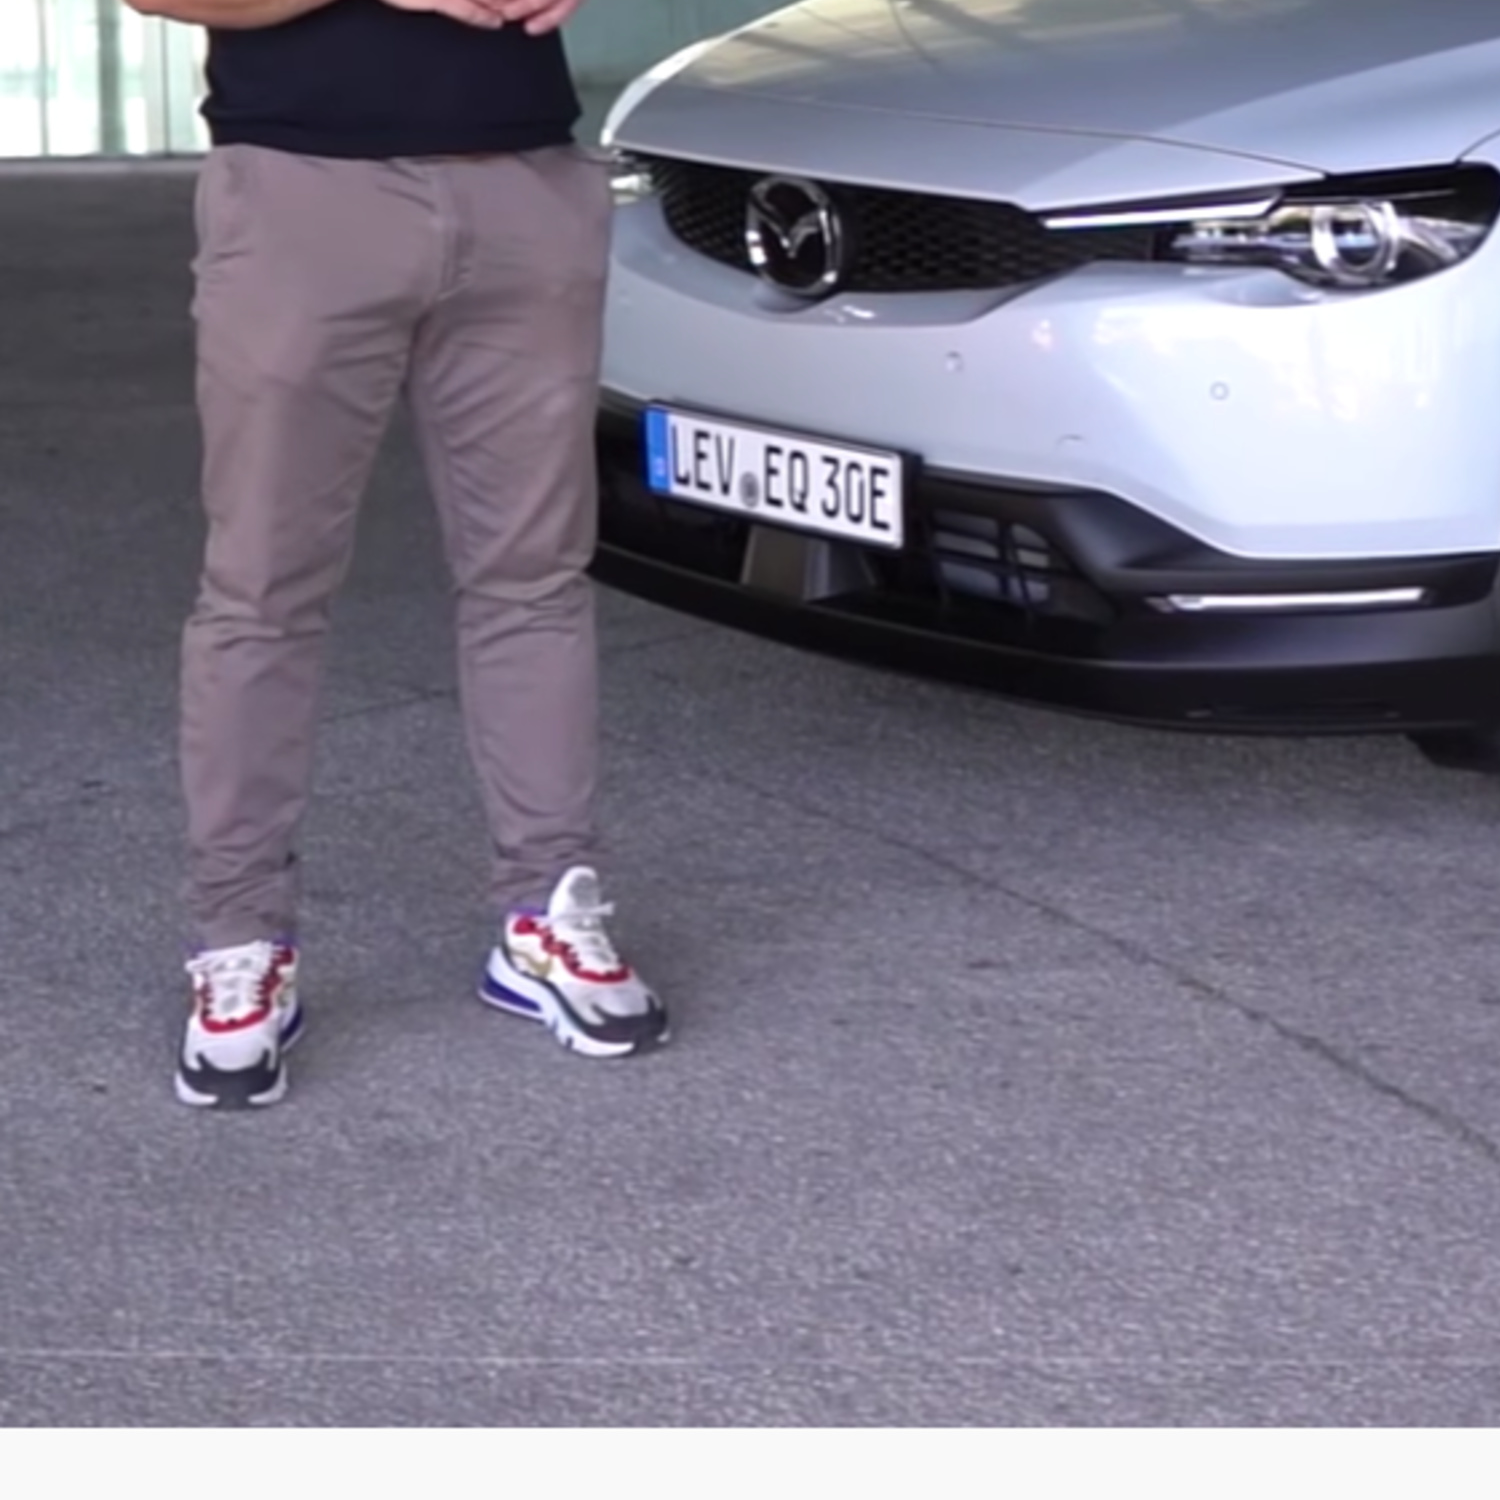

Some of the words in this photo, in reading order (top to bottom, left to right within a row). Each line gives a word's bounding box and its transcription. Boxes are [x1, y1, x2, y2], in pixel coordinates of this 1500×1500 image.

[671, 423, 736, 497] LEV
[764, 444, 809, 516] EQ
[820, 454, 891, 532] 30E
